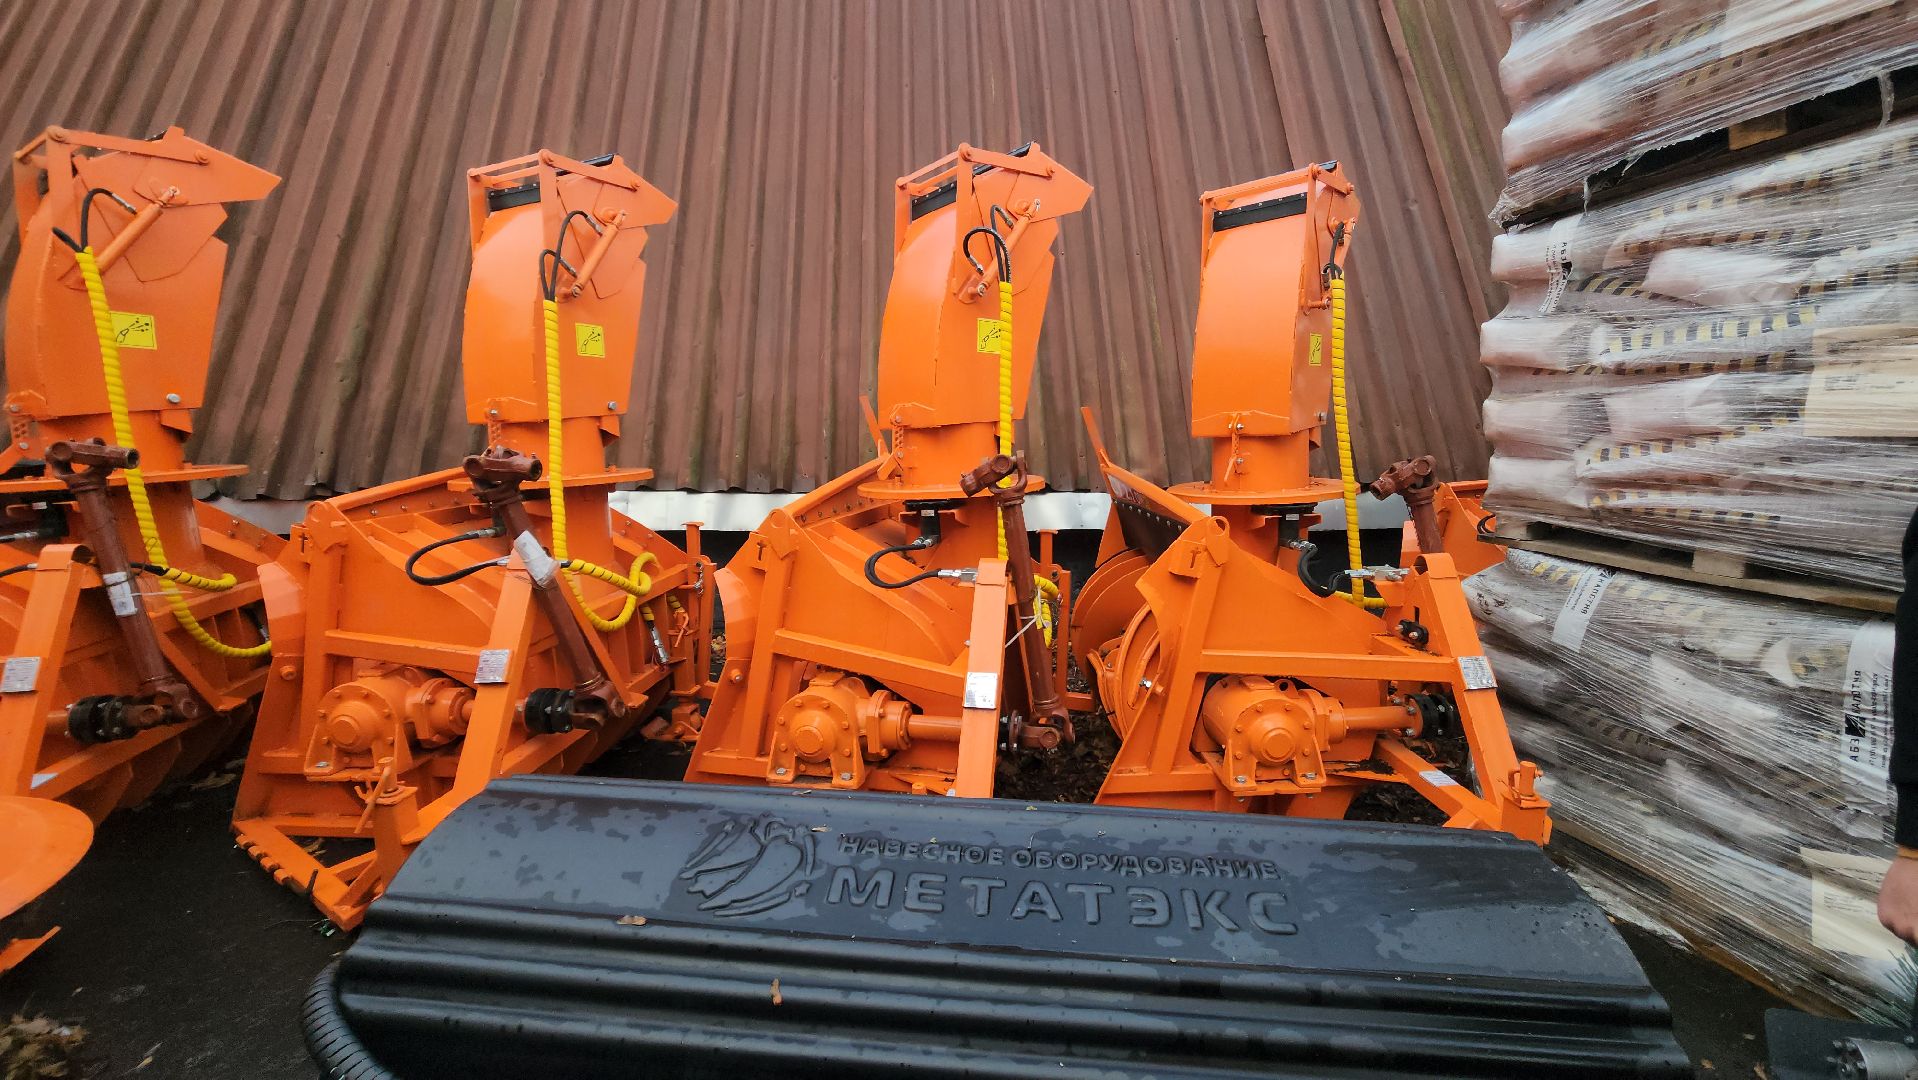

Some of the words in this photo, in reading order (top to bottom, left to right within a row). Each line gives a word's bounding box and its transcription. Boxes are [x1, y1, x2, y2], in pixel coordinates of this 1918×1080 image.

[1849, 738, 1860, 762] АБЗ
[838, 834, 1005, 867] НАВЕСНОЕ
[1010, 848, 1283, 881] ОБОРУДОВАНИЕ
[826, 864, 1299, 936] МЕТАТЭКС
